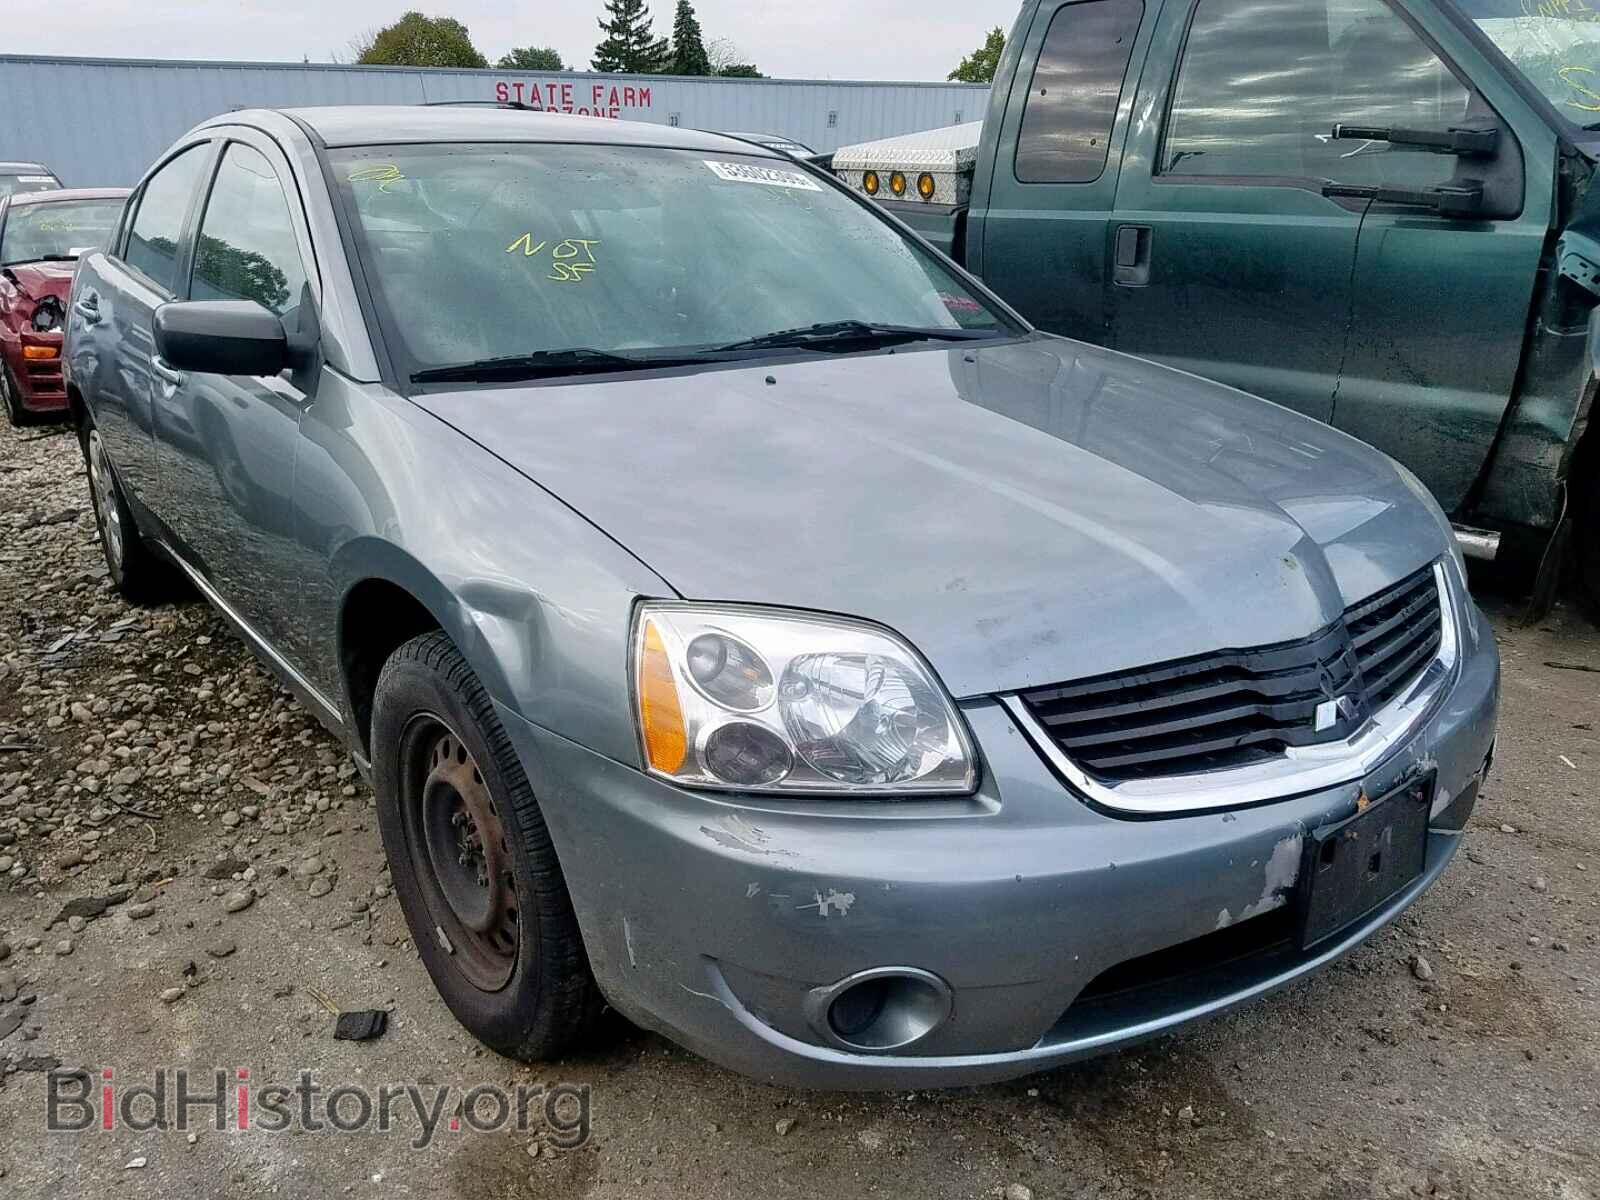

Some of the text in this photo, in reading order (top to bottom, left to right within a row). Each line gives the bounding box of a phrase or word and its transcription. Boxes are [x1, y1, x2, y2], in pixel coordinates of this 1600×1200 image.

[495, 81, 651, 108] STATE FARM
[505, 232, 602, 263] NOT
